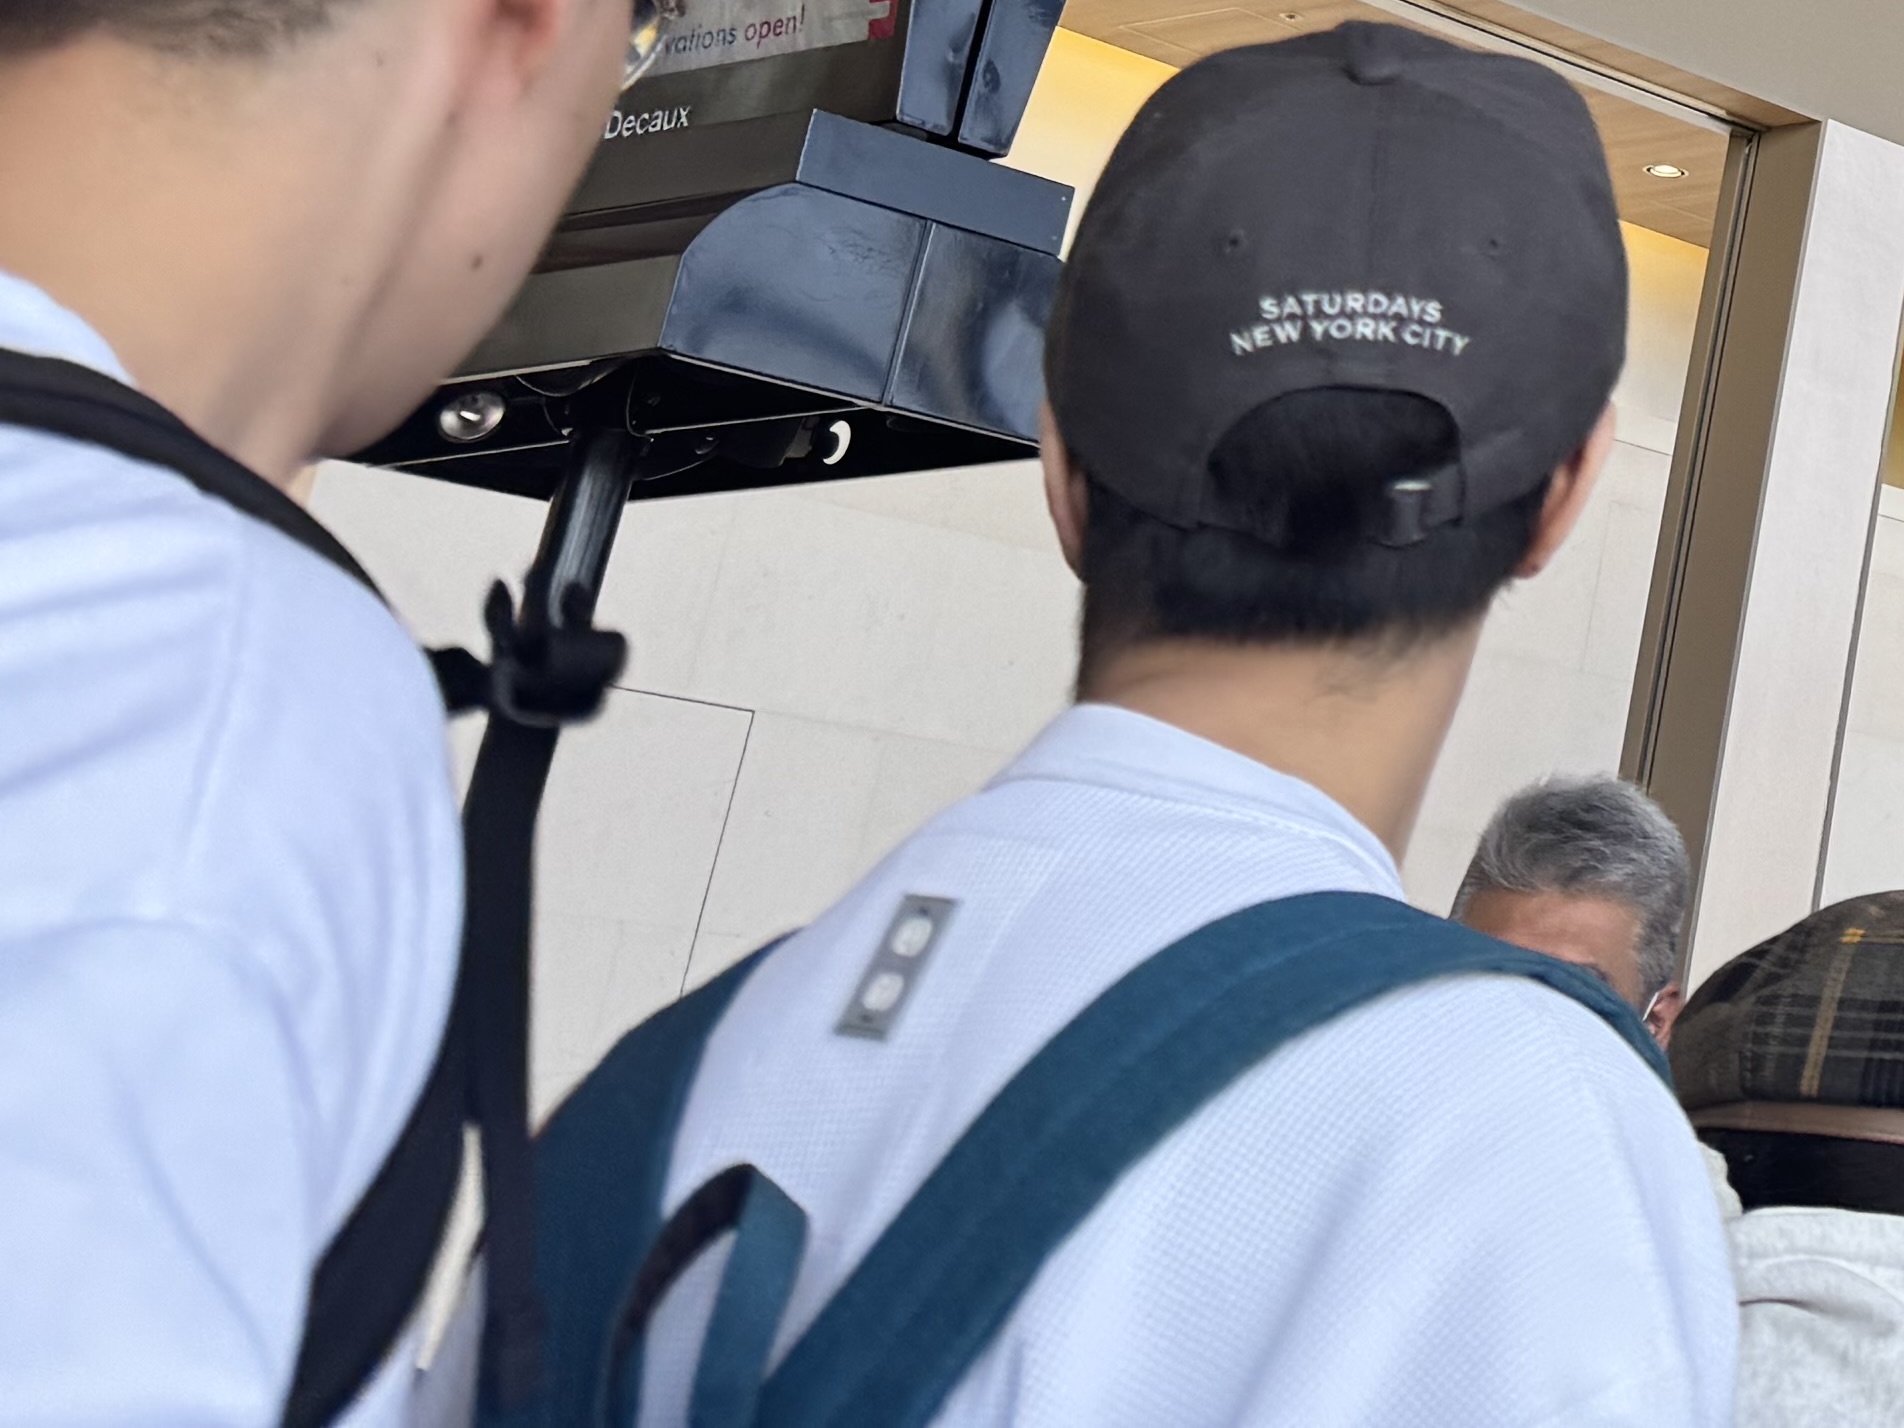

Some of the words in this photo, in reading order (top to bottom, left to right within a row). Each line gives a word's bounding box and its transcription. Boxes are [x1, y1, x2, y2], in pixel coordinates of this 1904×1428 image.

[744, 2, 806, 49] open!
[604, 105, 692, 140] Decaux
[1259, 292, 1443, 324] SATURDAYS
[1229, 320, 1302, 356] NEW
[1309, 317, 1397, 343] YORK
[1401, 323, 1470, 356] CITY
